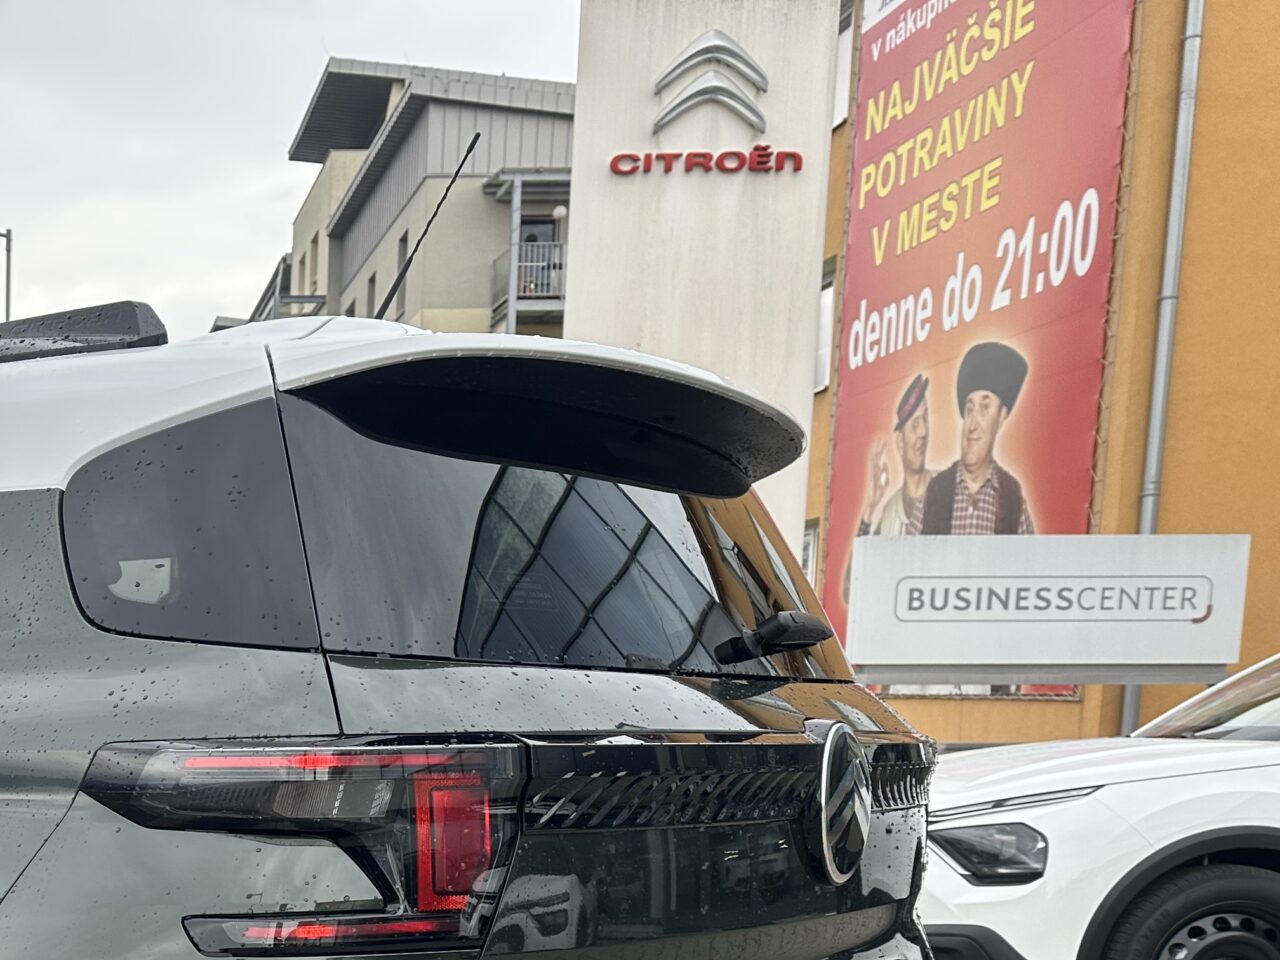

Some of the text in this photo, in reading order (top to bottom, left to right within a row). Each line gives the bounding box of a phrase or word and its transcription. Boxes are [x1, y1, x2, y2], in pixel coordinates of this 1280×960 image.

[864, 0, 1036, 141] NAJVÄČŠIE
[872, 38, 882, 62] v
[858, 60, 1036, 209] POTRAVINY
[848, 187, 1099, 369] denne do 21:00
[871, 157, 1003, 266] V MESTE
